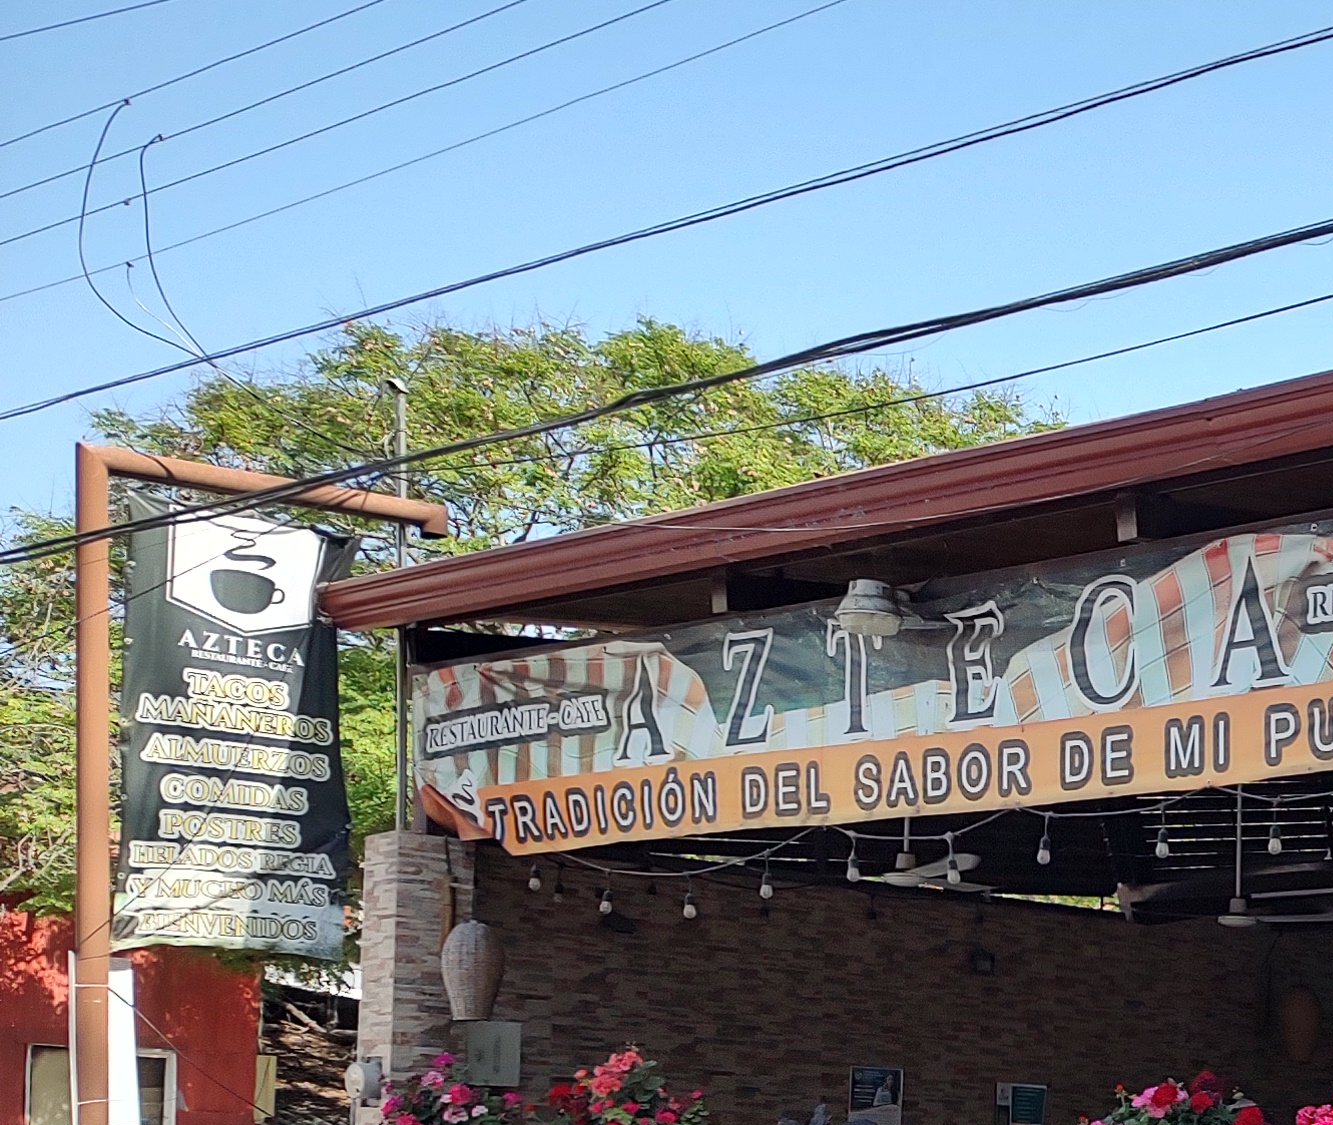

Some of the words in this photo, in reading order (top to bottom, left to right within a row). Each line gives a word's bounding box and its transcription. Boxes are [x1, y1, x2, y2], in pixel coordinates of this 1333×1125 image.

[178, 628, 305, 667] AZTECA
[615, 550, 1293, 765] AZTECA
[184, 669, 287, 708] TACOS
[142, 734, 329, 780] ALMUERZOS
[160, 774, 307, 814] COMIDAS
[486, 766, 716, 843] TRADICIÓN
[743, 759, 830, 819] DEL
[855, 739, 1031, 811] SABOR
[1060, 725, 1134, 790] DE
[1165, 712, 1230, 778] MI
[160, 811, 300, 849] POSTRES
[131, 843, 252, 869] HELADOS
[130, 876, 150, 899] Y
[155, 877, 264, 901] MUCHO
[267, 878, 328, 907] MÁS
[138, 911, 319, 941] BIENVENIDOS
